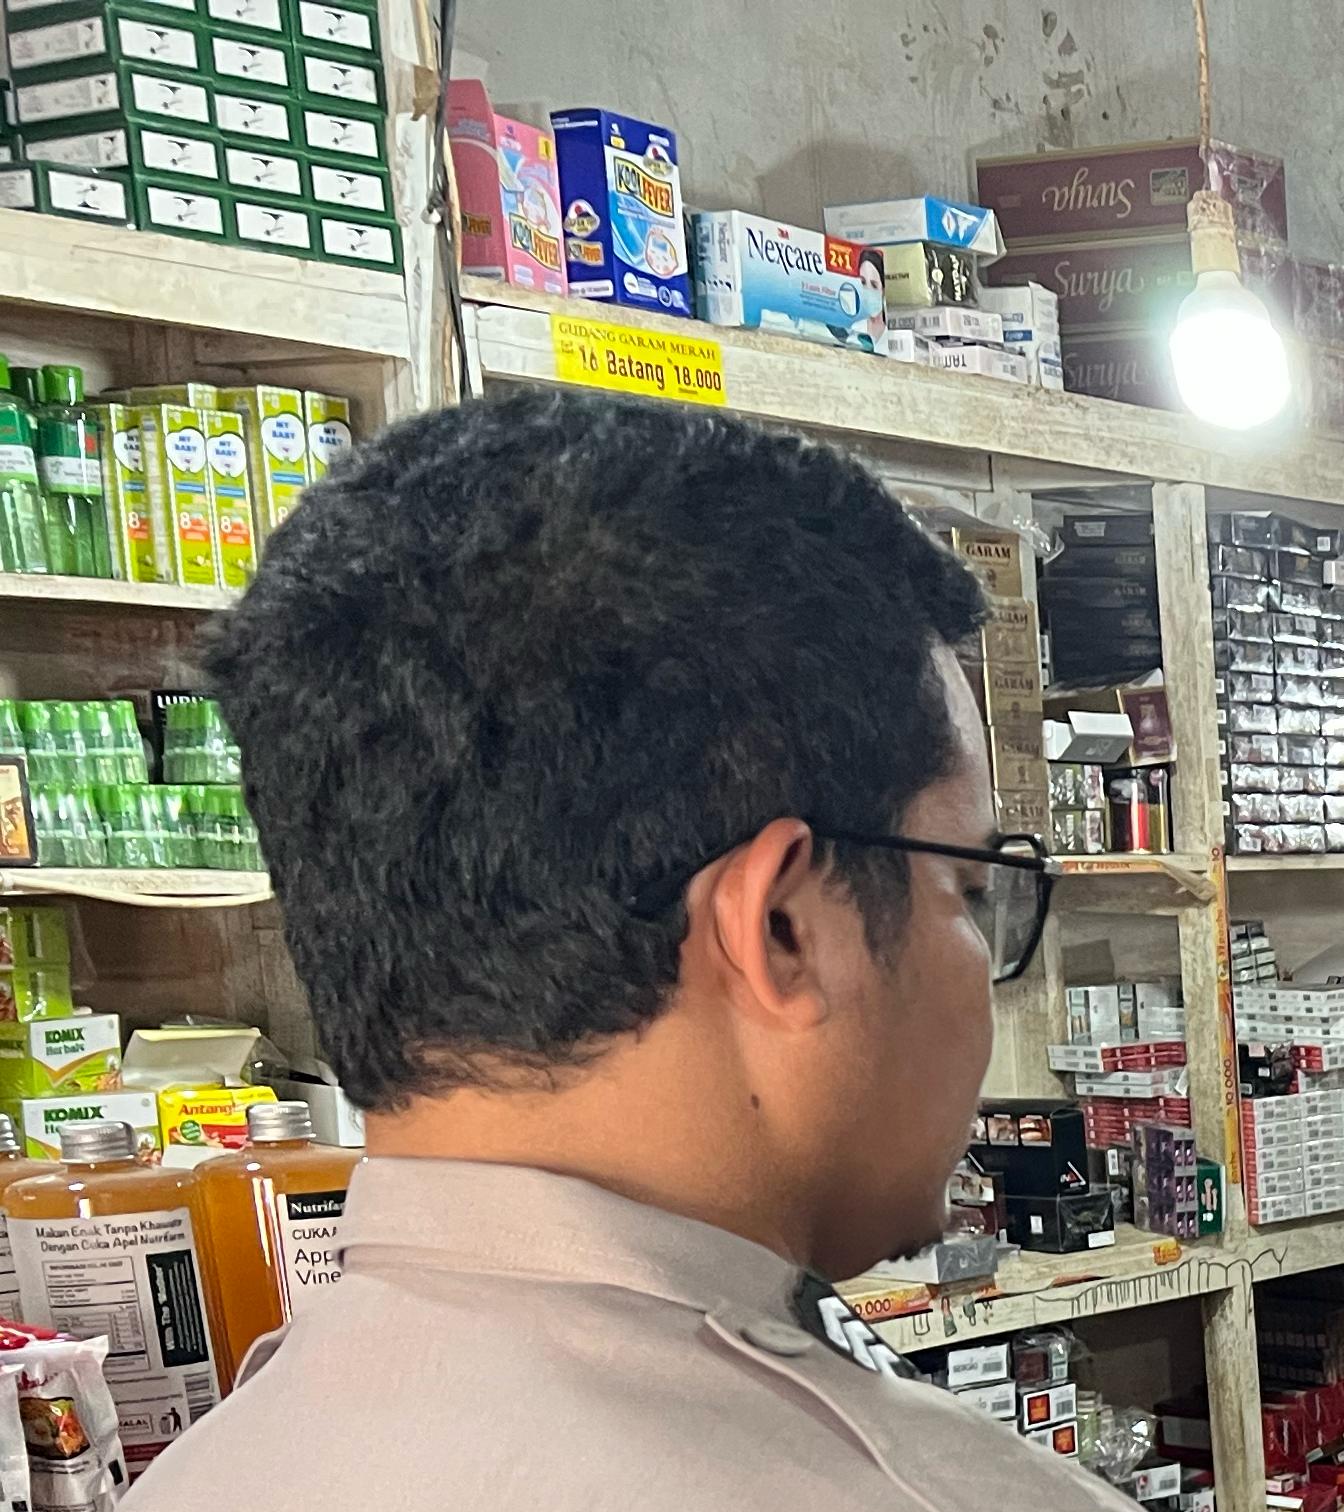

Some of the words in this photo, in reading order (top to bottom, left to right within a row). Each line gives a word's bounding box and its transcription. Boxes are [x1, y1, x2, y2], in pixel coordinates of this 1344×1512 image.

[1043, 167, 1135, 218] Surya
[746, 227, 823, 276] Nexcare
[1054, 260, 1144, 312] Surya
[619, 333, 666, 352] GARAM
[669, 341, 715, 361] MERAH
[607, 350, 665, 391] Batang
[966, 544, 1011, 560] GARAM
[45, 1027, 85, 1044] KOMIX
[44, 1105, 104, 1123] KOMIX
[291, 1201, 345, 1215] Nutrifar
[104, 1223, 138, 1237] Tanpa
[292, 1228, 329, 1242] CUKA
[294, 1248, 334, 1271] App
[295, 1267, 341, 1287] Vine
